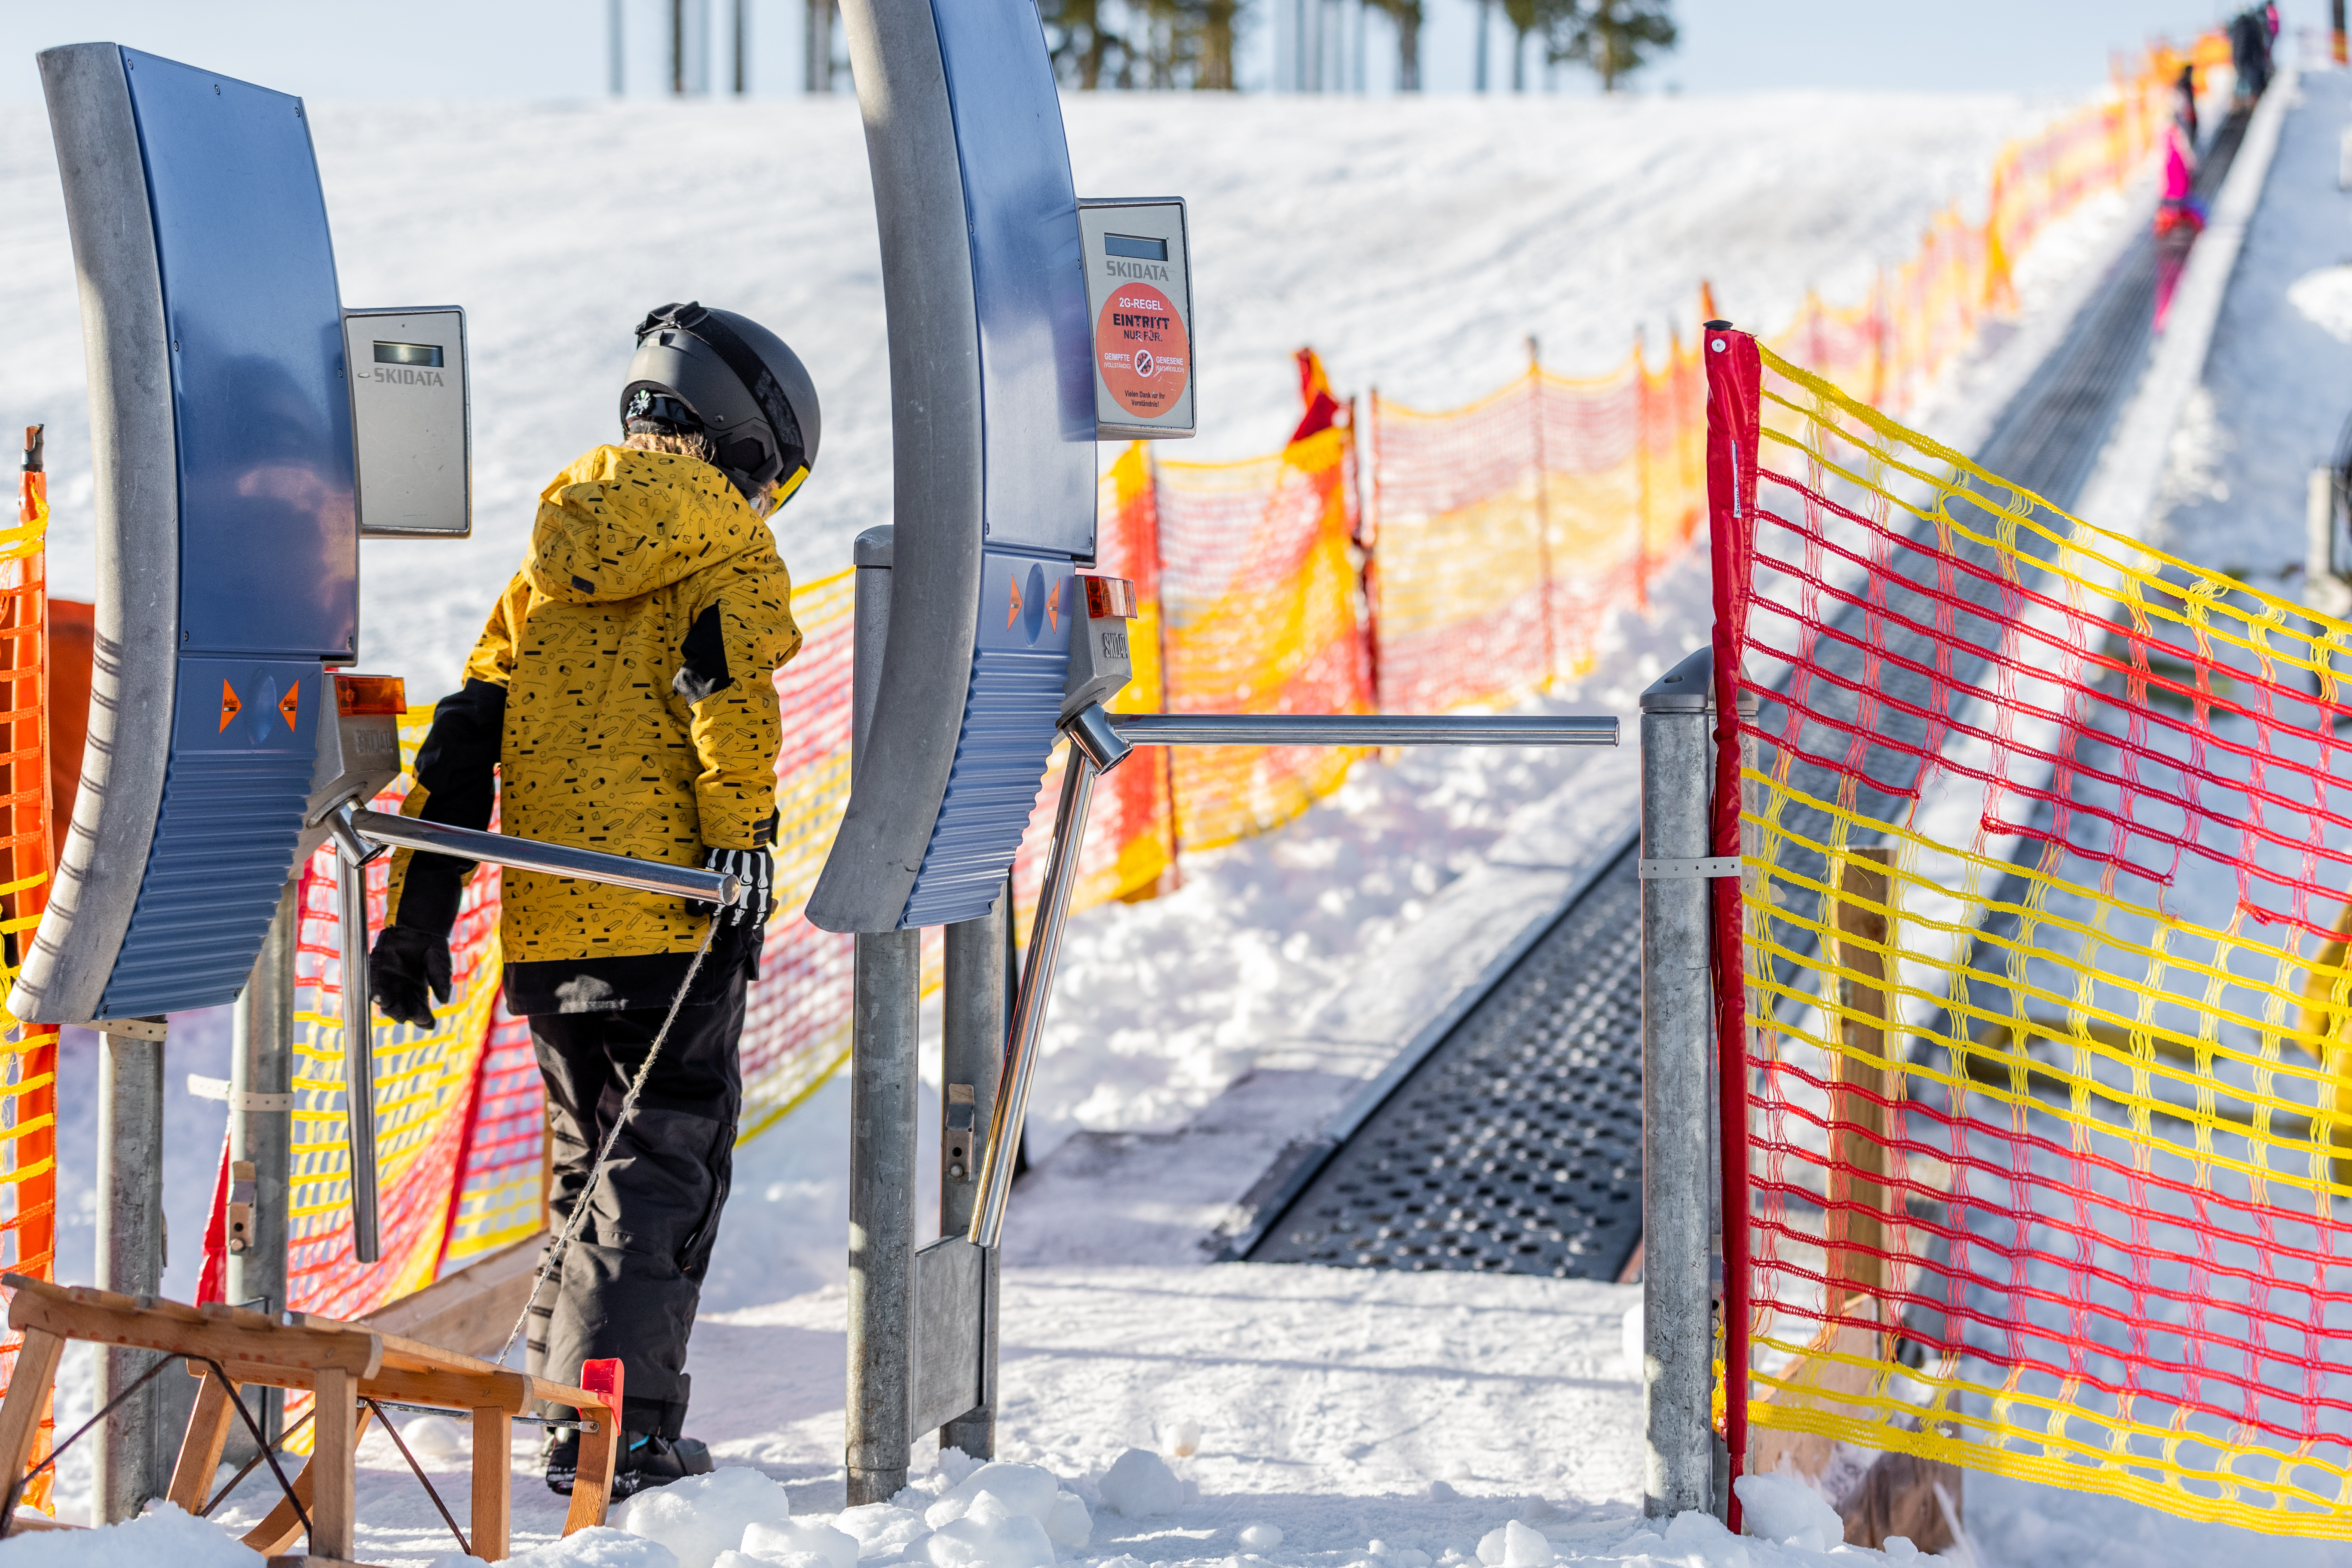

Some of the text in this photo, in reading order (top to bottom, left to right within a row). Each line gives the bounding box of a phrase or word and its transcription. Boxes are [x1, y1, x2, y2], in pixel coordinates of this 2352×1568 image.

[1107, 260, 1169, 282] SKIDATA
[1119, 297, 1163, 311] 2G-REGEL
[1113, 313, 1170, 330] EINTRITT
[1124, 329, 1142, 340] NUR
[1104, 352, 1130, 361] GEIMPFTE
[1156, 356, 1183, 365] GENESENE
[1104, 361, 1131, 370] (VOLLSTÄNDIG)
[374, 368, 444, 387] SKIDATA
[1131, 399, 1159, 407] Verständnis!
[1103, 633, 1128, 658] SKIDATA
